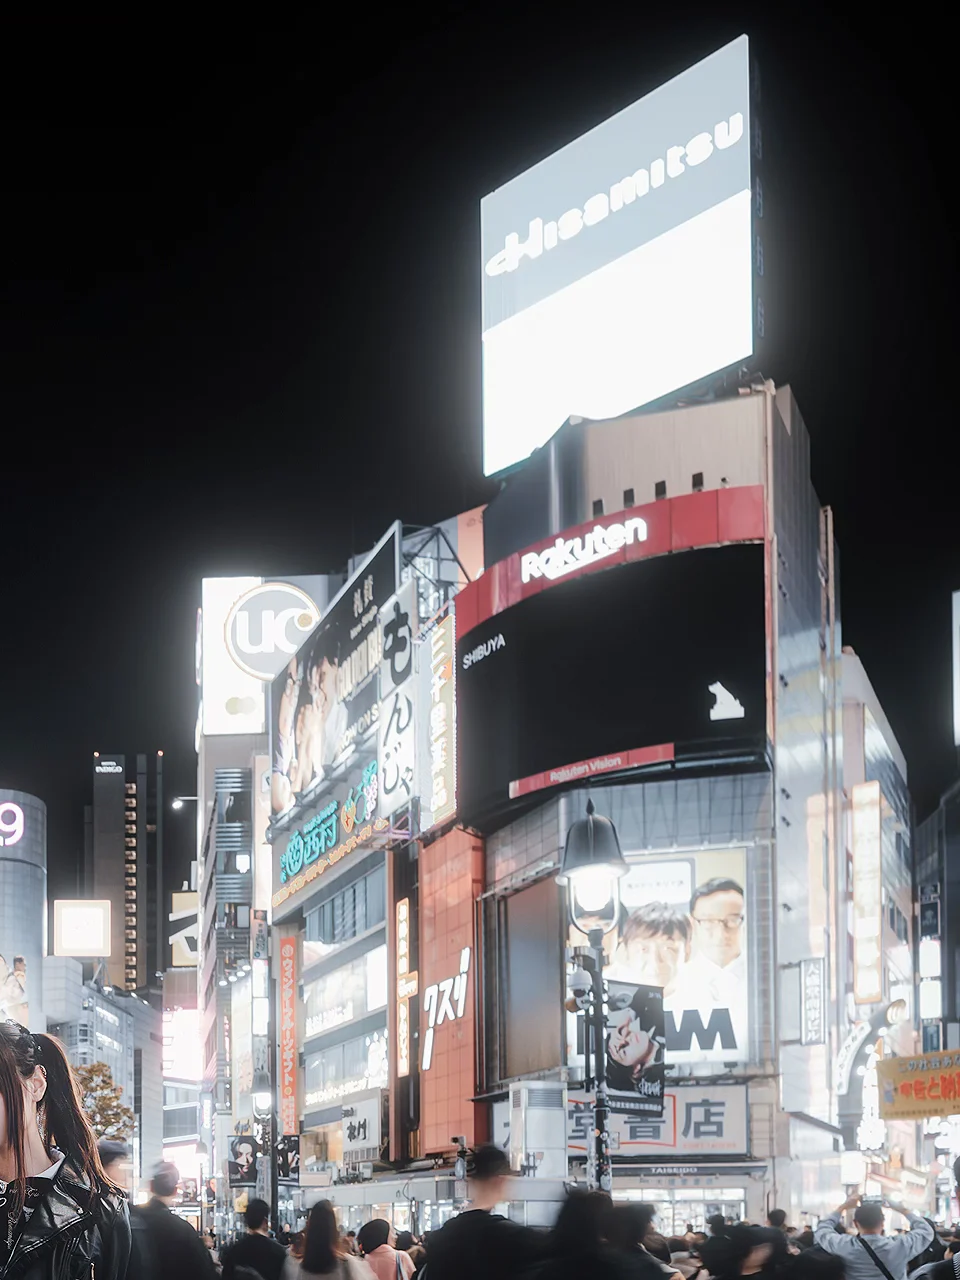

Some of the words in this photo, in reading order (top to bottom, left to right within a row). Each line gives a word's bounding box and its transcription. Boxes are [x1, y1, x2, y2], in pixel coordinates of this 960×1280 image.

[485, 112, 743, 277] Hisamitsu
[521, 516, 648, 584] Rakuten
[462, 633, 507, 670] SHIBUYA
[383, 601, 413, 798] もんじゃ
[550, 762, 587, 782] Rakuten
[590, 755, 622, 773] Vision
